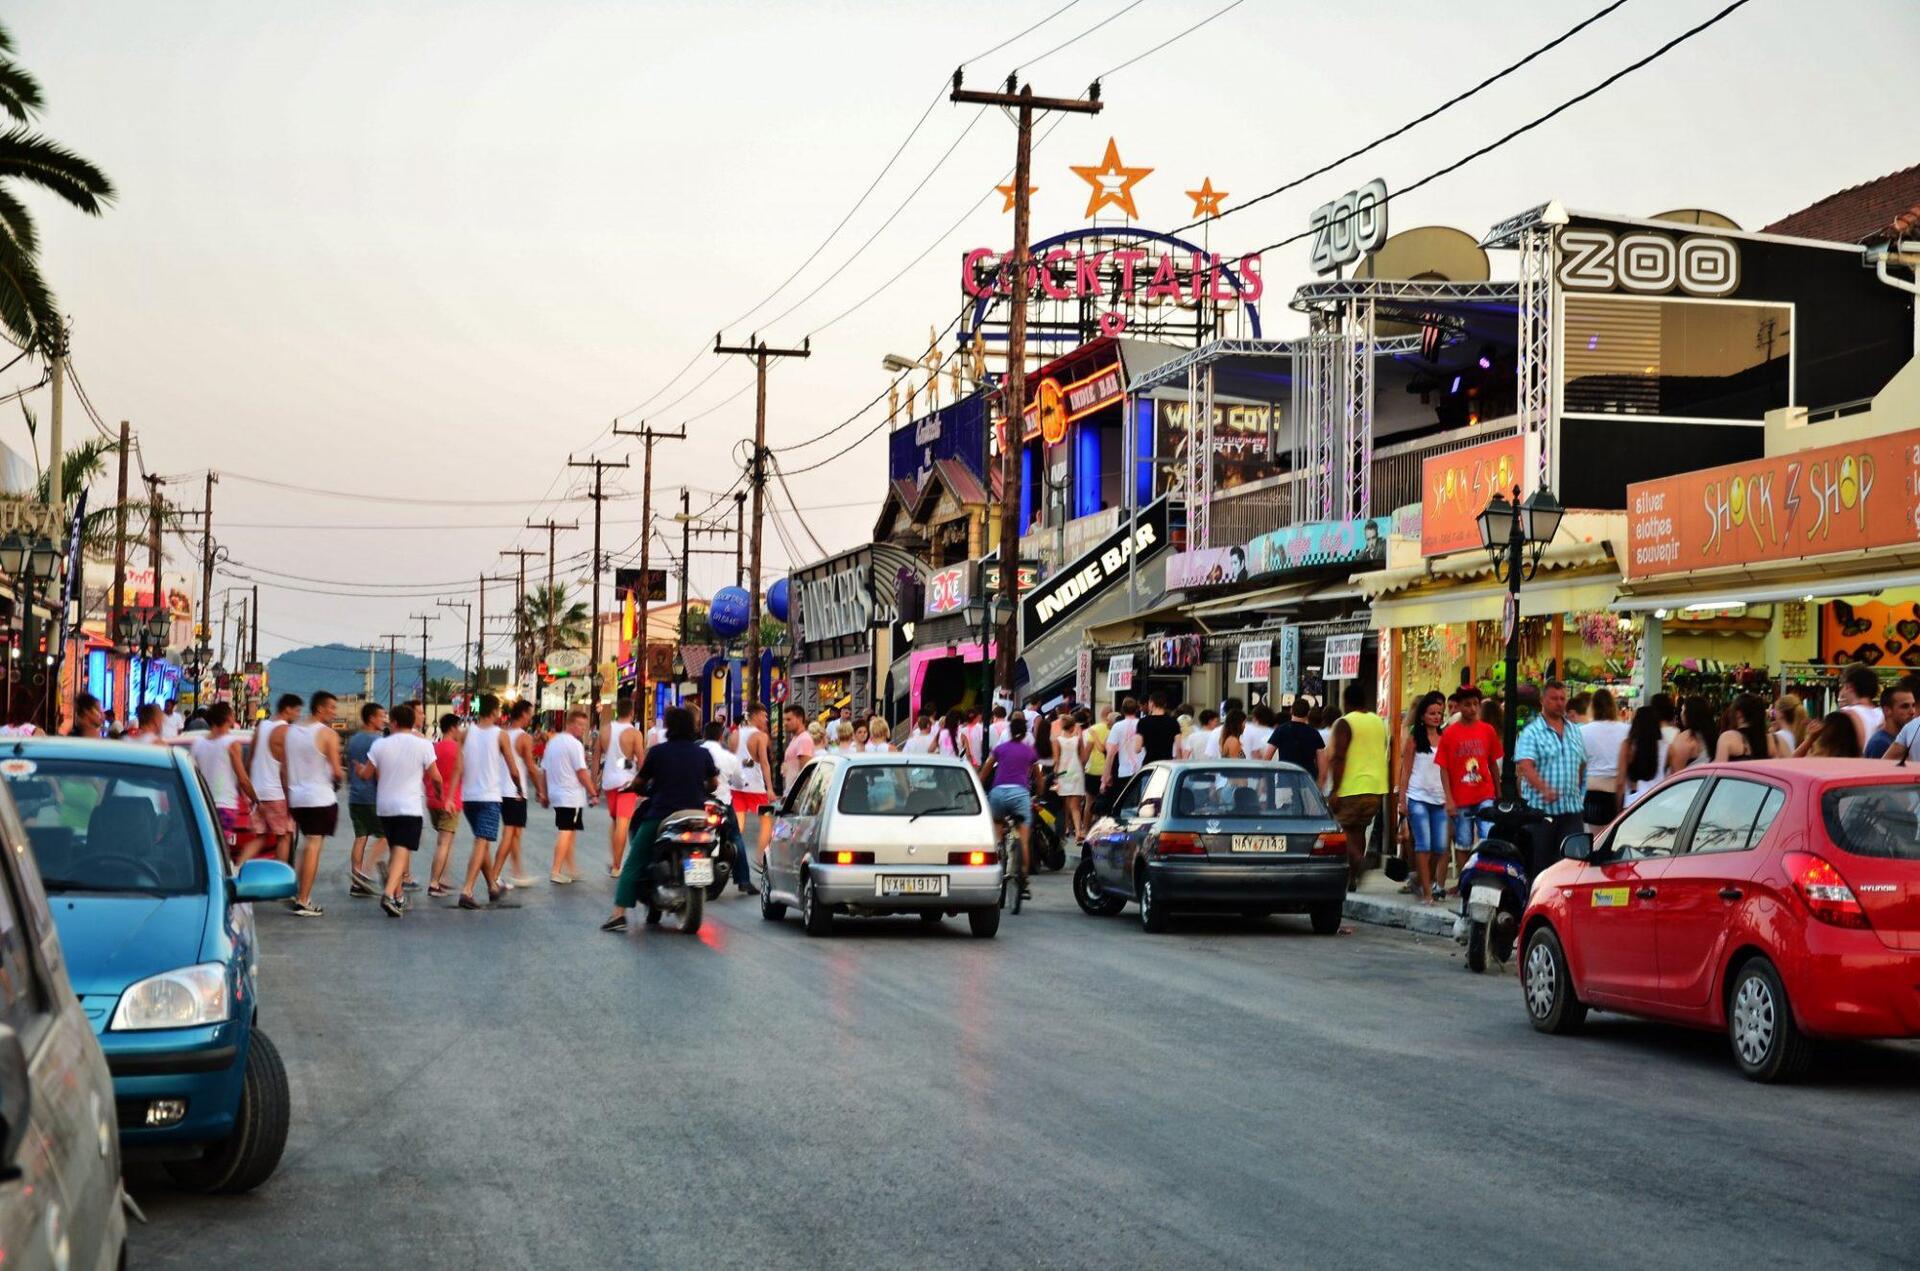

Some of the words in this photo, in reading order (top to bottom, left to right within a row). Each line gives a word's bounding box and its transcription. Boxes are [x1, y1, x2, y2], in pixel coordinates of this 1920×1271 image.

[1310, 178, 1387, 276] ZOO
[962, 247, 1263, 302] COCKTAILS
[1558, 230, 1740, 296] ZOO
[1636, 491, 1666, 515] silver
[1703, 469, 1778, 556] SHOCK
[1807, 453, 1876, 542] SHOP
[1636, 537, 1681, 566] souvenir
[1035, 560, 1103, 624] INDIE
[1100, 522, 1158, 576] BAR
[1239, 661, 1253, 679] LIVE
[1327, 656, 1341, 675] LIVE
[1258, 837, 1285, 850] 7143
[913, 878, 939, 891] 1917
